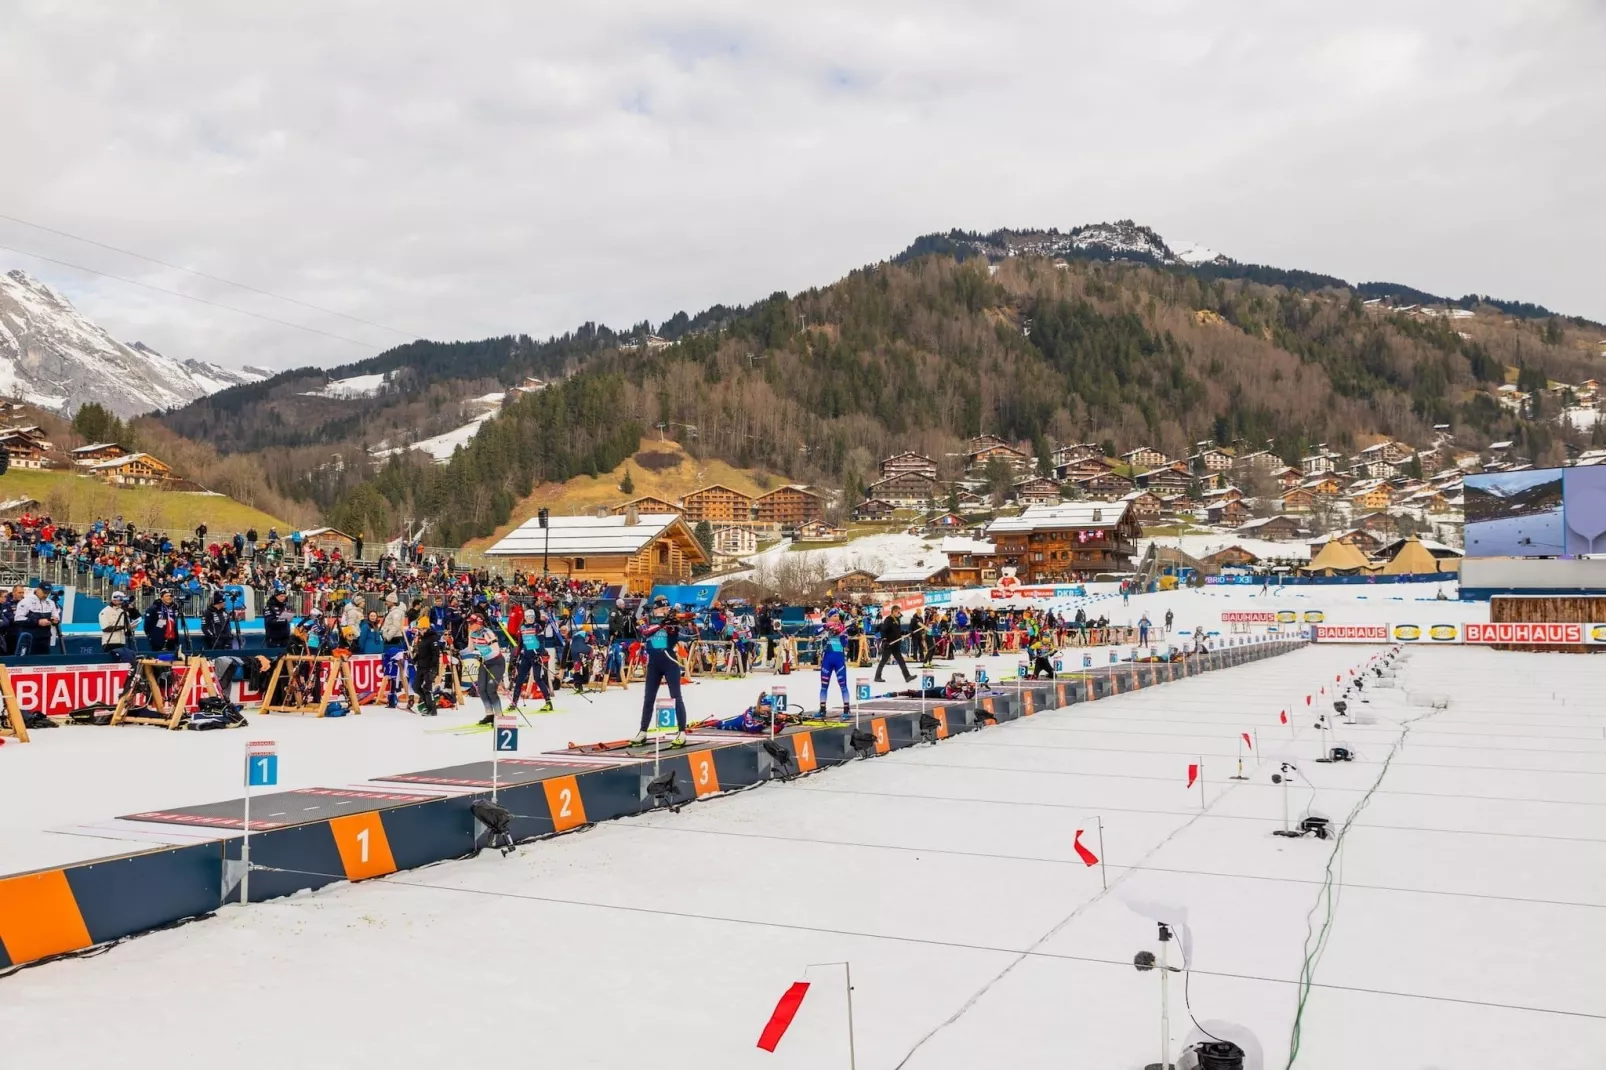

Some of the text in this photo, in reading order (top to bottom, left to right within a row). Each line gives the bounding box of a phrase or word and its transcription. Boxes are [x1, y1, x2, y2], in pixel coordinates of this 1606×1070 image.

[1056, 589, 1074, 598] DKB
[1222, 613, 1275, 622] BAUHAUS
[1317, 627, 1387, 638] BAUHAUS
[1466, 625, 1581, 642] BAUHAUS
[926, 678, 933, 689] 6
[860, 686, 868, 699] 5
[777, 695, 785, 710] 4
[661, 709, 671, 726] 3
[500, 729, 512, 750] 2
[877, 726, 885, 745] 5
[801, 741, 809, 762] 4
[257, 758, 268, 782] 1
[700, 760, 709, 785] 3
[560, 788, 571, 817] 2
[357, 828, 370, 862] 1
